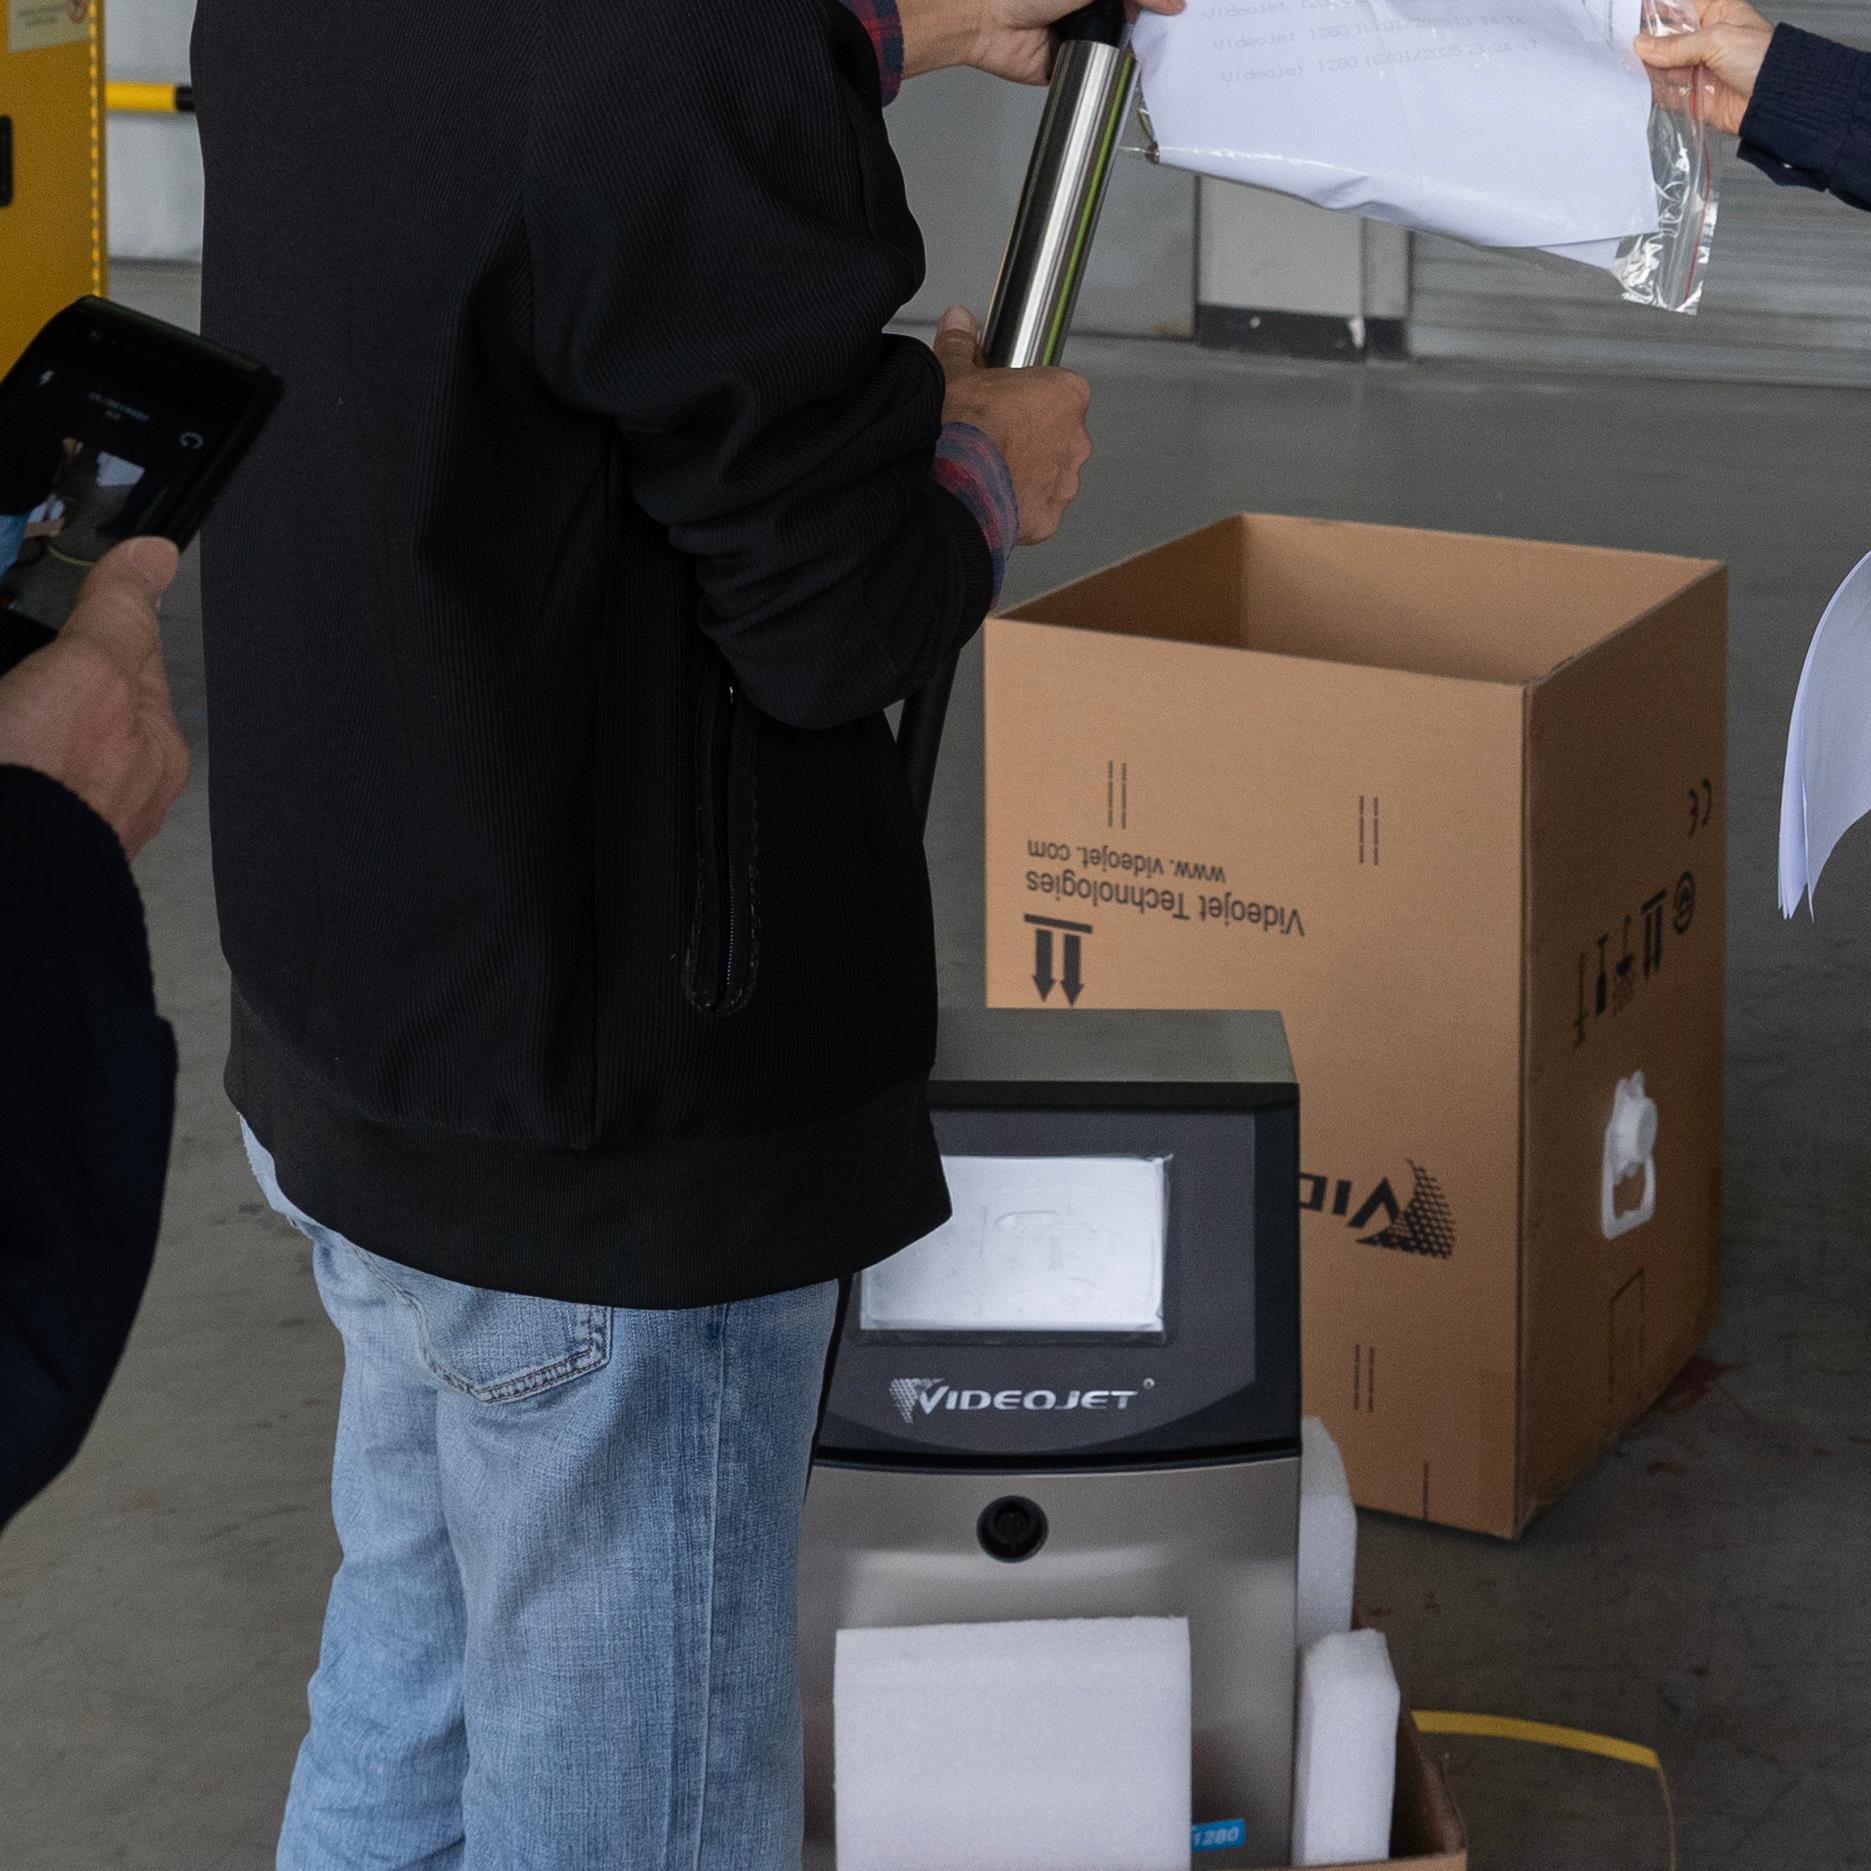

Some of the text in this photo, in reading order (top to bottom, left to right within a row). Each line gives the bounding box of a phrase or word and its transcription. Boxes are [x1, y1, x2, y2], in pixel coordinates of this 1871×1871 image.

[1024, 868, 1306, 938] Videojet Technologies
[916, 1384, 1139, 1416] VIDEOJET
